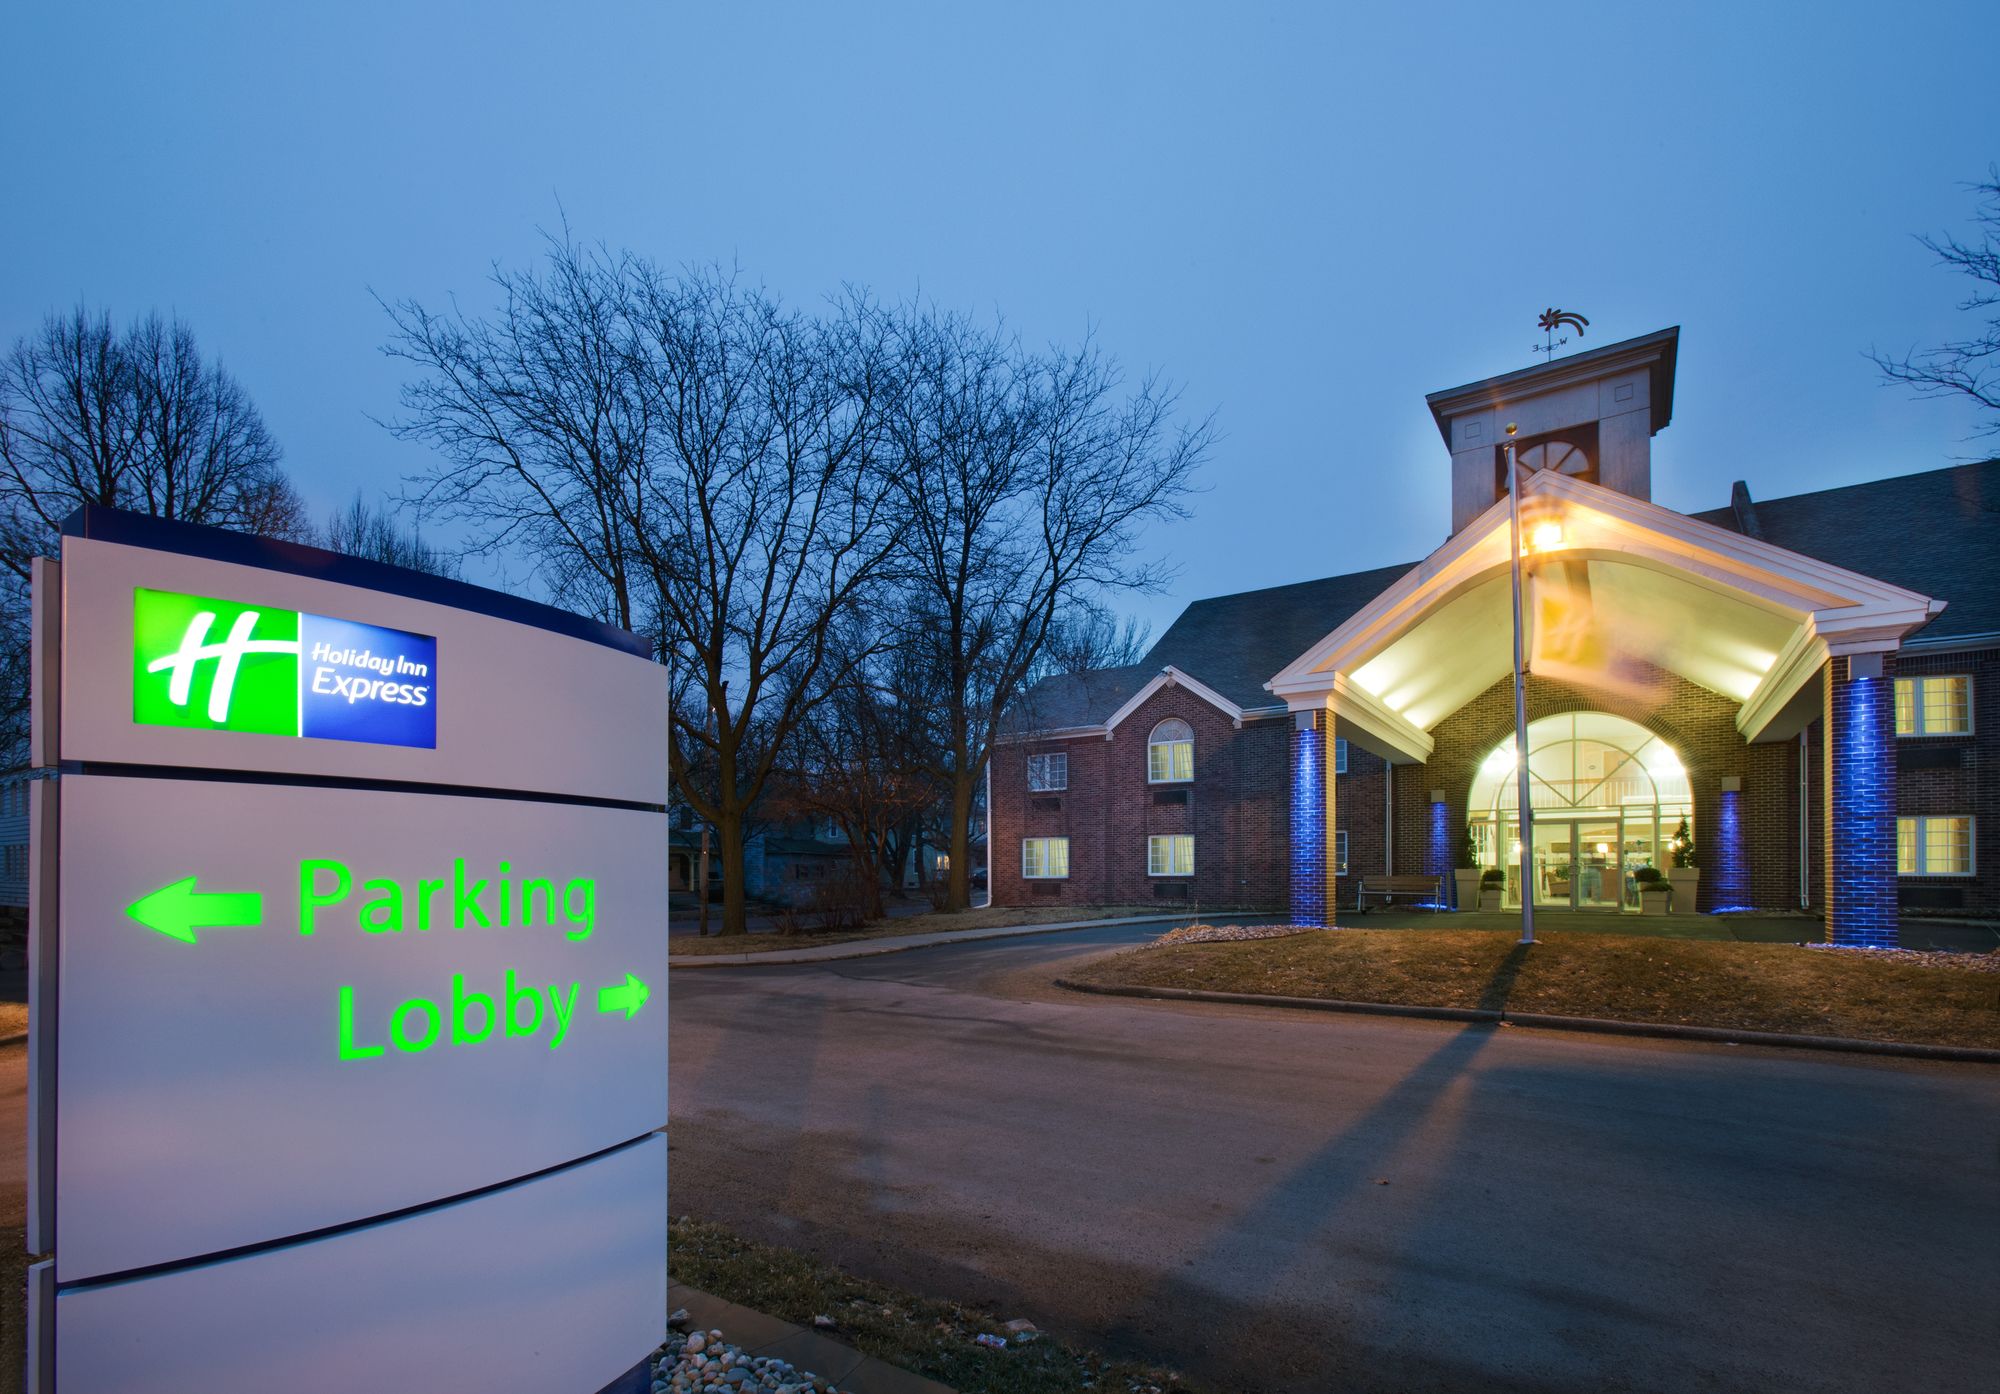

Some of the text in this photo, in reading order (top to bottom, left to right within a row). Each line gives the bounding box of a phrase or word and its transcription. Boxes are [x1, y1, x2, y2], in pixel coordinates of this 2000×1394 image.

[311, 642, 428, 677] Holiday Inn
[311, 666, 428, 706] Express
[299, 858, 593, 941] Parking
[339, 969, 580, 1061] Lobby
